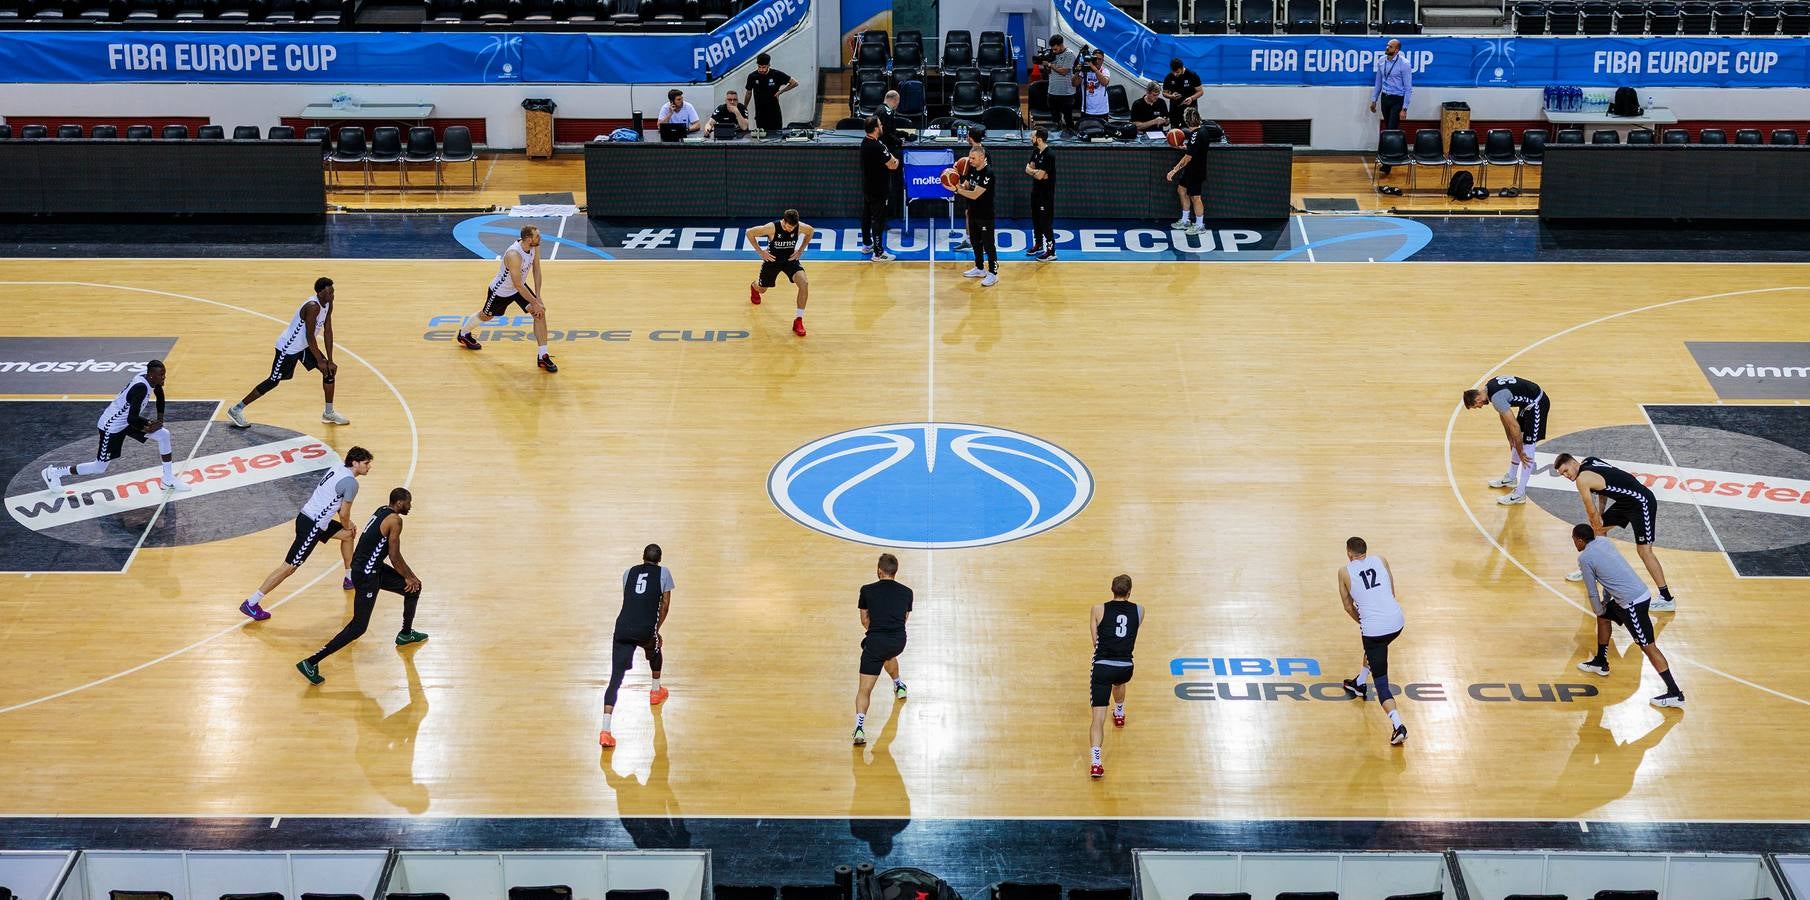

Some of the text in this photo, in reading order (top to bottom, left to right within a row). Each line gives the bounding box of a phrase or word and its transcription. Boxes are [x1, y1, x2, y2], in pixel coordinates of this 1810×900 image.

[1074, 0, 1106, 32] CUP
[694, 0, 796, 69] FIBA EUROPE
[108, 44, 337, 71] FIBA EUROPE CUP
[1251, 50, 1298, 72] FIBA
[1400, 50, 1434, 73] UP
[1593, 51, 1778, 74] FIBA EUROPE CUP
[912, 175, 941, 185] molte
[648, 330, 750, 342] CUP
[15, 443, 327, 518] winmasters
[635, 573, 649, 594] 5
[1359, 568, 1381, 590] 12
[1115, 614, 1128, 638] 3
[1169, 657, 1322, 677] FIBA
[1468, 683, 1600, 702] CUP
